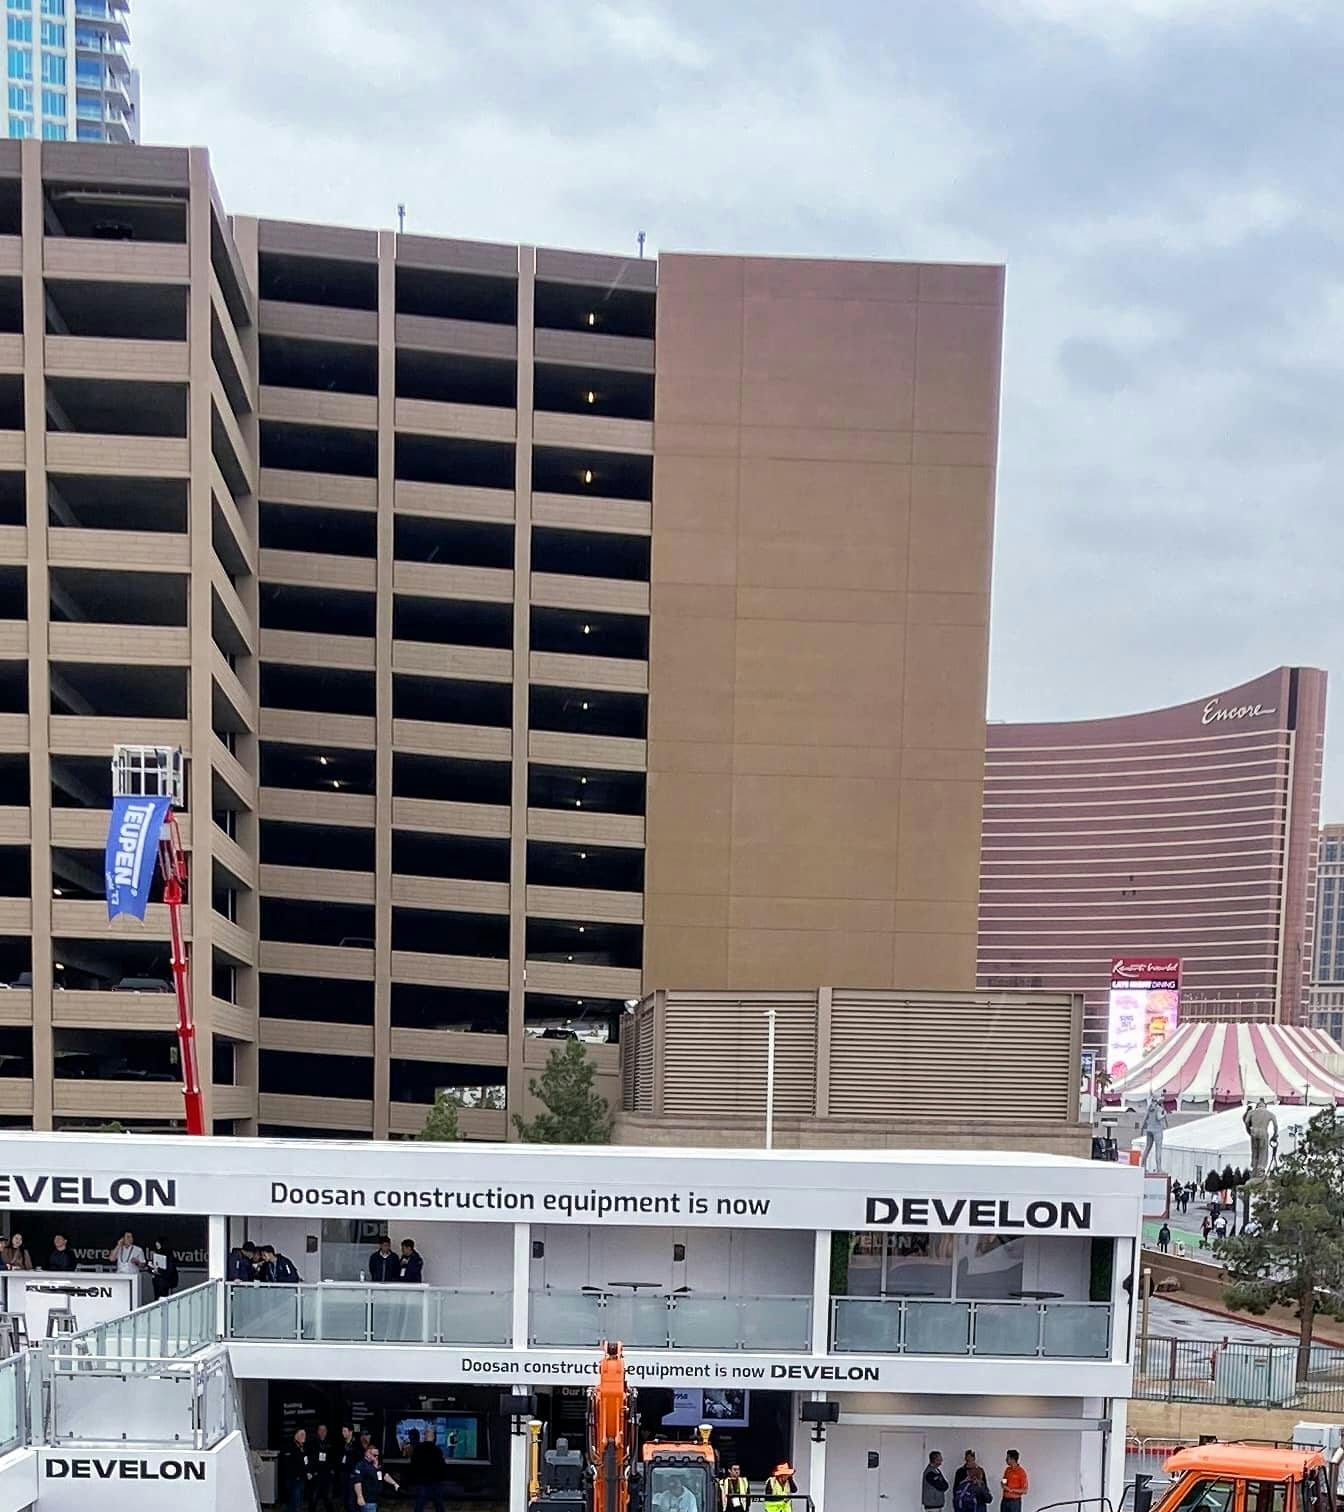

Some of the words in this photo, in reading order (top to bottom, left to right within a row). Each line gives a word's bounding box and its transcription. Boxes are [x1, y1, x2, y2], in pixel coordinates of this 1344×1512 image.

[1201, 698, 1276, 725] Encore
[114, 803, 156, 888] TEUPEN
[271, 1182, 366, 1207] Doosan
[374, 1183, 535, 1213] construction
[543, 1191, 680, 1218] equipment
[688, 1192, 709, 1215] is
[717, 1197, 771, 1216] now
[866, 1197, 1091, 1230] DEVELON
[461, 1358, 519, 1374] Doosan
[628, 1362, 711, 1381] equipment
[714, 1364, 728, 1378] is
[732, 1366, 766, 1379] now
[771, 1364, 880, 1381] DEVELON
[45, 1457, 206, 1481] DEVELON
